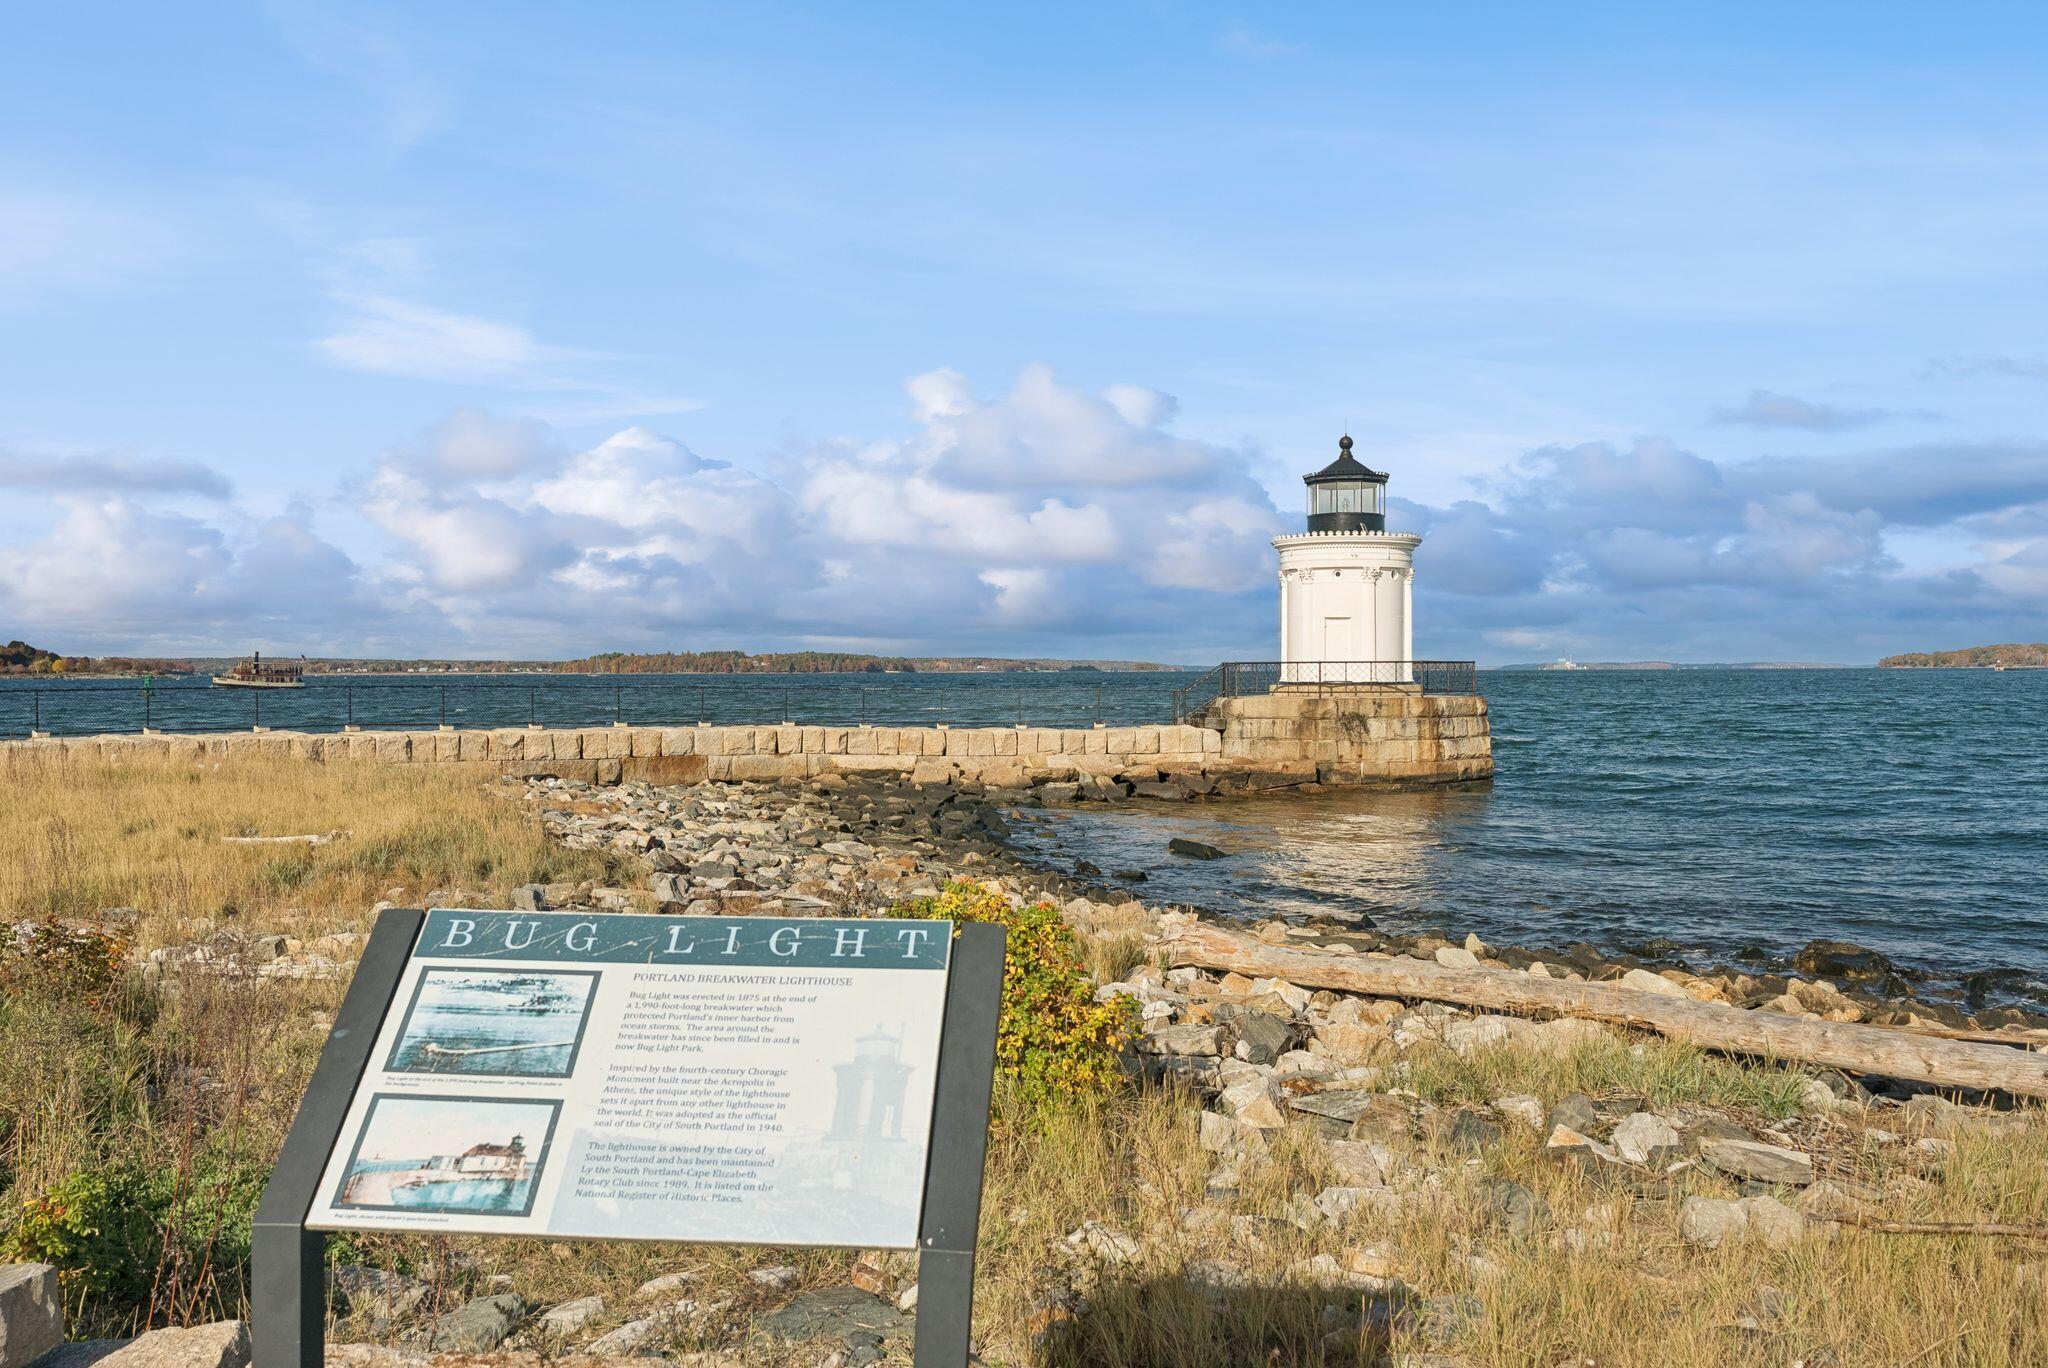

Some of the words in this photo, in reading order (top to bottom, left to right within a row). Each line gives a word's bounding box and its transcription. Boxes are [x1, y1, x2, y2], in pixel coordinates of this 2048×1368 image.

[441, 919, 597, 952] BUG
[664, 925, 928, 959] LIGHT
[634, 973, 694, 983] PORTLAND
[698, 974, 776, 984] BREAKWATER
[779, 976, 852, 986] LIGHTHOUSE
[629, 992, 646, 1000] Bug
[649, 992, 670, 1000] Light
[634, 1002, 701, 1011] 1,990-foot-long
[668, 1013, 712, 1021] Portland's
[773, 1015, 795, 1023] from
[618, 1033, 669, 1041] breakwater
[737, 1035, 760, 1043] filled
[637, 1044, 654, 1052] Bug
[656, 1044, 679, 1053] Light
[609, 1064, 647, 1073] Inspired
[649, 1066, 660, 1074] by
[678, 1066, 745, 1075] fourth-century
[748, 1068, 788, 1076] Choragic
[606, 1075, 656, 1083] Monument
[658, 1076, 678, 1084] built
[721, 1079, 764, 1087] Acropolis
[656, 1089, 687, 1097] unique
[690, 1089, 711, 1097] style
[742, 1090, 790, 1098] lighthouse
[629, 1099, 654, 1107] apart
[656, 1099, 678, 1107] from
[726, 1101, 775, 1110] lighthouse
[614, 1109, 643, 1117] world.
[675, 1111, 712, 1120] adopted
[745, 1113, 777, 1121] official
[643, 1121, 661, 1129] City
[704, 1123, 744, 1131] Portland
[608, 1143, 656, 1151] lighthouse
[670, 1145, 700, 1153] owned
[703, 1145, 715, 1154] by
[717, 1146, 731, 1154] the
[734, 1147, 753, 1155] City
[584, 1153, 611, 1161] South
[614, 1154, 654, 1163] Portland
[677, 1157, 693, 1165] has
[696, 1158, 718, 1166] been
[721, 1159, 774, 1167] maintained
[612, 1166, 639, 1174] South
[642, 1167, 709, 1178] Portland-Cape
[712, 1169, 757, 1178] Elizabeth
[578, 1177, 610, 1187] Rotary
[612, 1179, 634, 1187] Club
[636, 1180, 659, 1188] since
[715, 1182, 740, 1190] listed
[758, 1184, 773, 1192] the
[575, 1189, 615, 1198] National
[617, 1191, 657, 1200] Register
[659, 1192, 669, 1200] of
[671, 1192, 709, 1201] Historic
